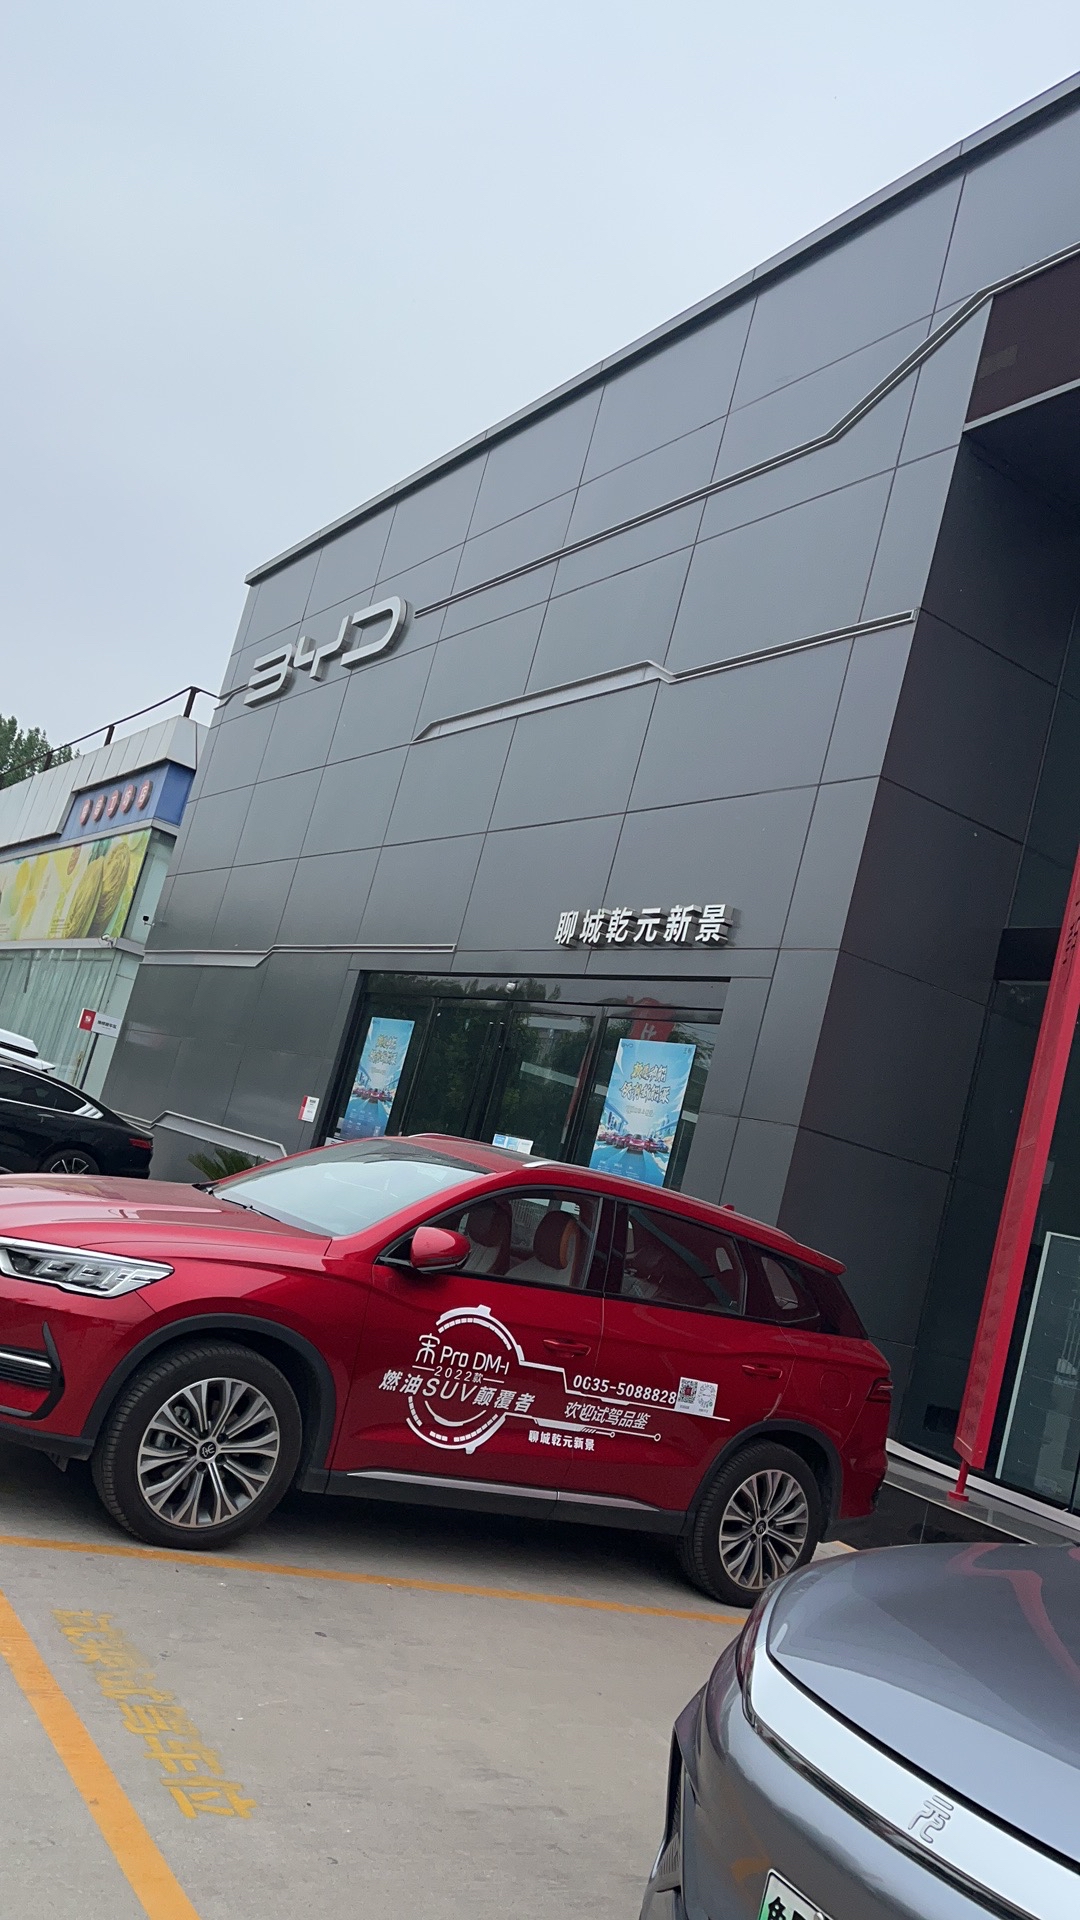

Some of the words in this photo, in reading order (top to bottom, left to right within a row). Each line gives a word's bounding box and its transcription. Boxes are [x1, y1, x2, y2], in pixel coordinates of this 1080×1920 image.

[244, 595, 407, 708] BYD
[553, 903, 727, 945] 聊城乾元新景
[415, 1333, 440, 1365] 宋
[439, 1346, 469, 1368] Pro
[378, 1369, 536, 1414] 燃油SUV颠覆者
[434, 1365, 484, 1384] 2022款
[564, 1401, 651, 1430] 欢迎试驾品鉴
[528, 1430, 596, 1452] 聊城乾元新景
